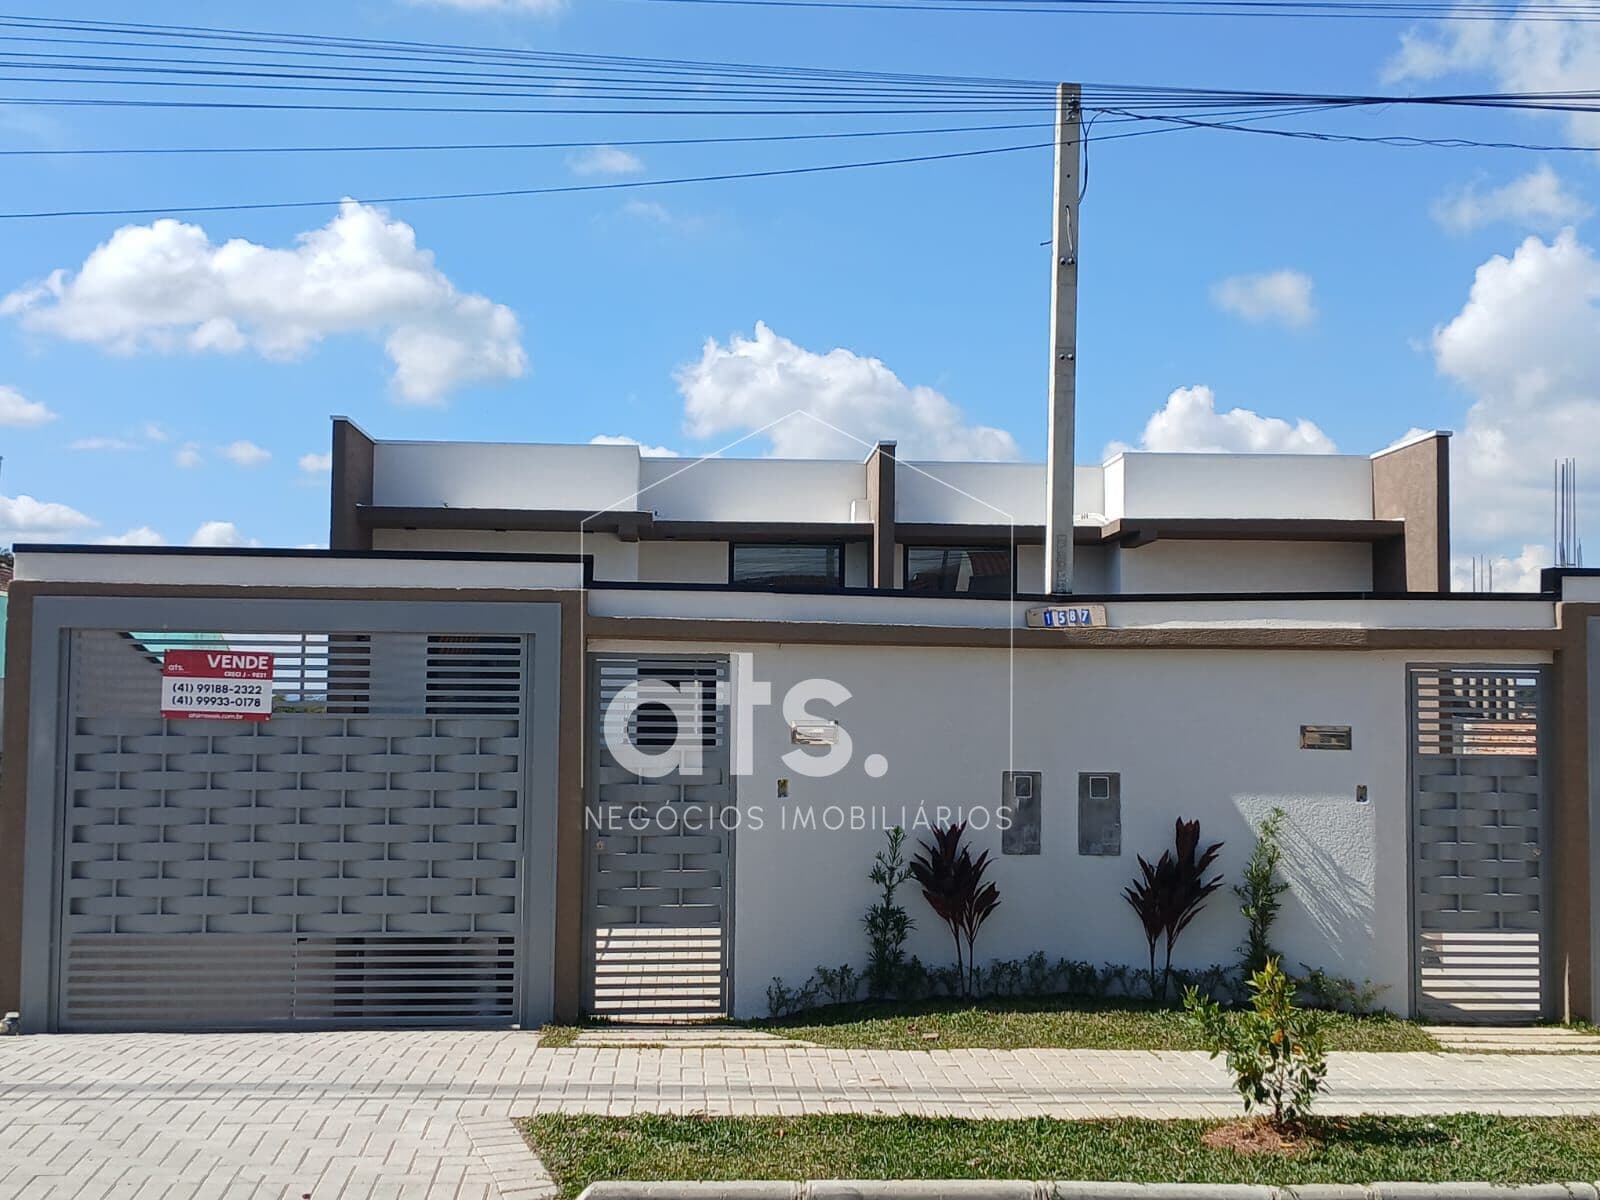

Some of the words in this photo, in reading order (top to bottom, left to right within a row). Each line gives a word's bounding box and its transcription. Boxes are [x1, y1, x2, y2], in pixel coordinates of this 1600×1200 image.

[1044, 610, 1089, 625] 1587
[207, 654, 269, 670] VENDE
[172, 683, 194, 693] (41)
[196, 683, 262, 694] 99188-2322
[172, 695, 193, 705] (41)
[196, 696, 261, 707] 99933-0178
